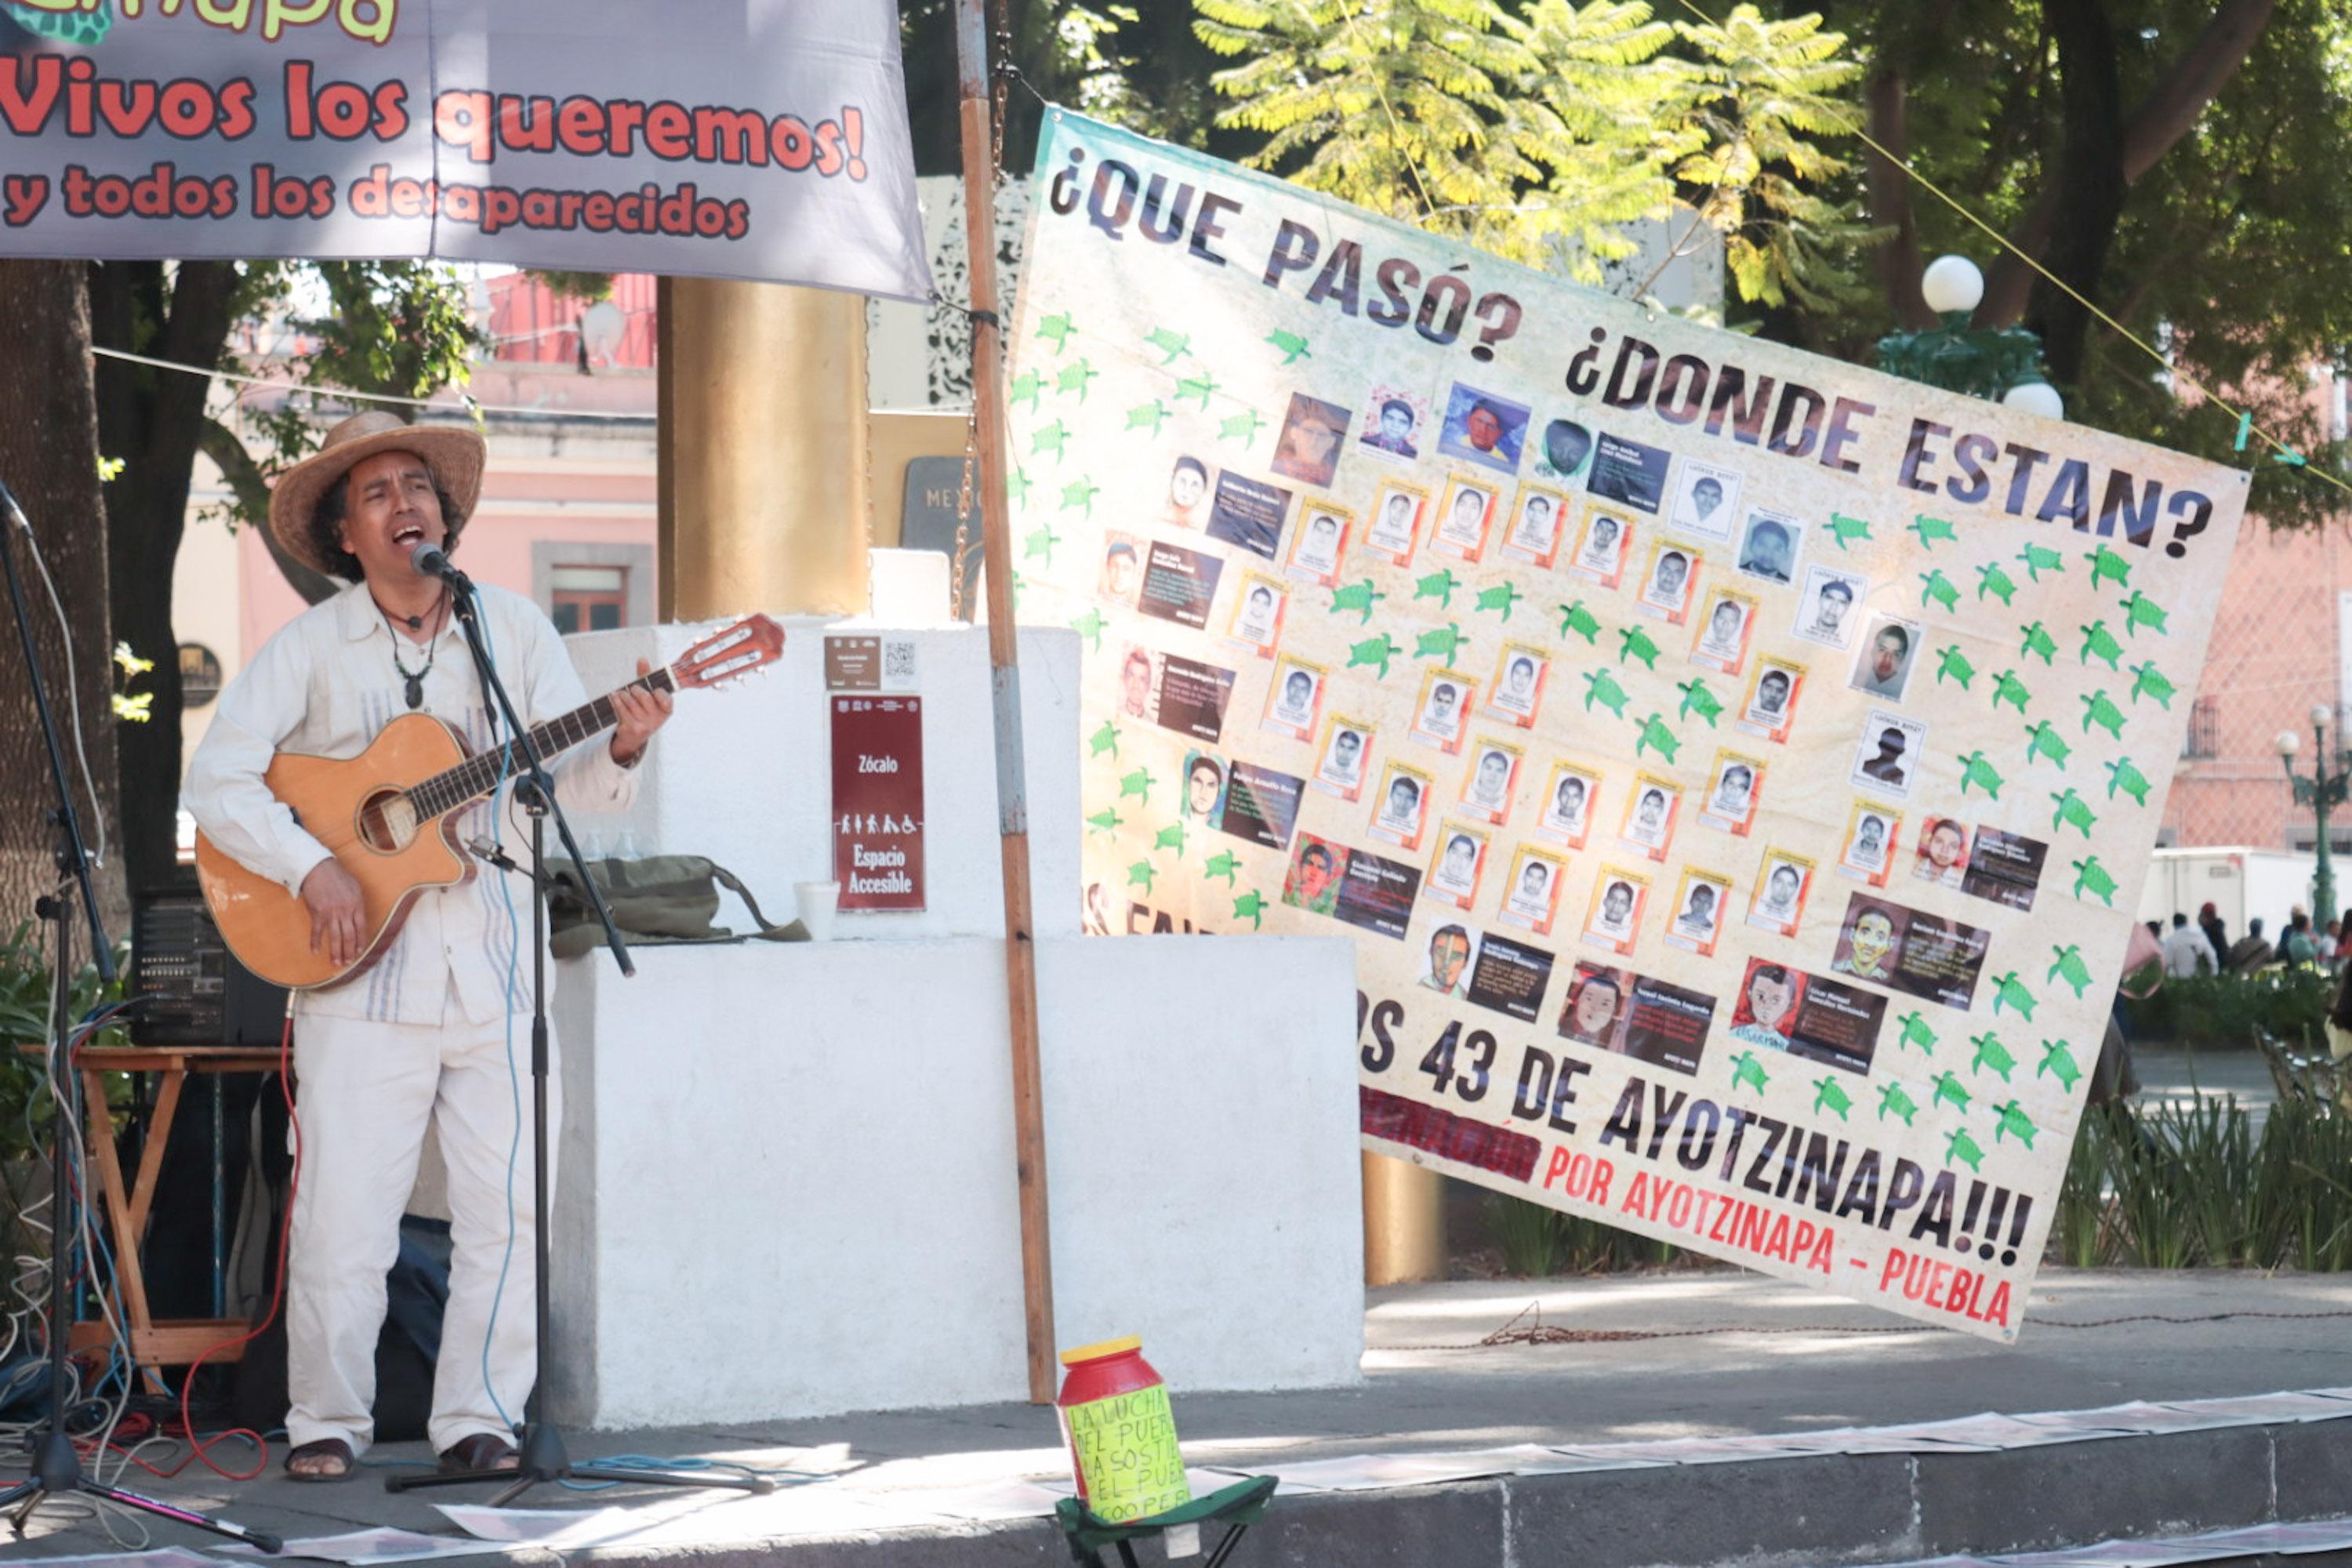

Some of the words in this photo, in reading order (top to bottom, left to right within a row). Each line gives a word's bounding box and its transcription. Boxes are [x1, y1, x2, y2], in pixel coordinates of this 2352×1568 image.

[0, 53, 256, 140] Vivos
[284, 59, 409, 143] los
[433, 89, 868, 181] queremos!
[4, 174, 49, 227] y
[62, 162, 237, 220] todos
[251, 162, 336, 220] los
[348, 162, 750, 241] desaparecidos
[1051, 147, 1243, 267] ¿QUE
[1262, 218, 1523, 363] PASÓ?
[1566, 326, 1876, 474] ¿DONDE
[1897, 417, 2213, 559] ESTAN?
[858, 755, 898, 774] Zócalo
[848, 871, 913, 894] Accesible
[853, 844, 906, 871] Espacio
[1419, 1020, 1497, 1102] 43
[1512, 1045, 1592, 1134] DE
[1599, 1076, 2034, 1267] AYOTZINAPA!!!
[1544, 1145, 1614, 1207] POR
[1621, 1171, 1836, 1275] AYOTZINAPA
[1879, 1247, 2013, 1327] PUEBLA
[1071, 1406, 1095, 1432] LA
[1098, 1477, 1123, 1501] EL
